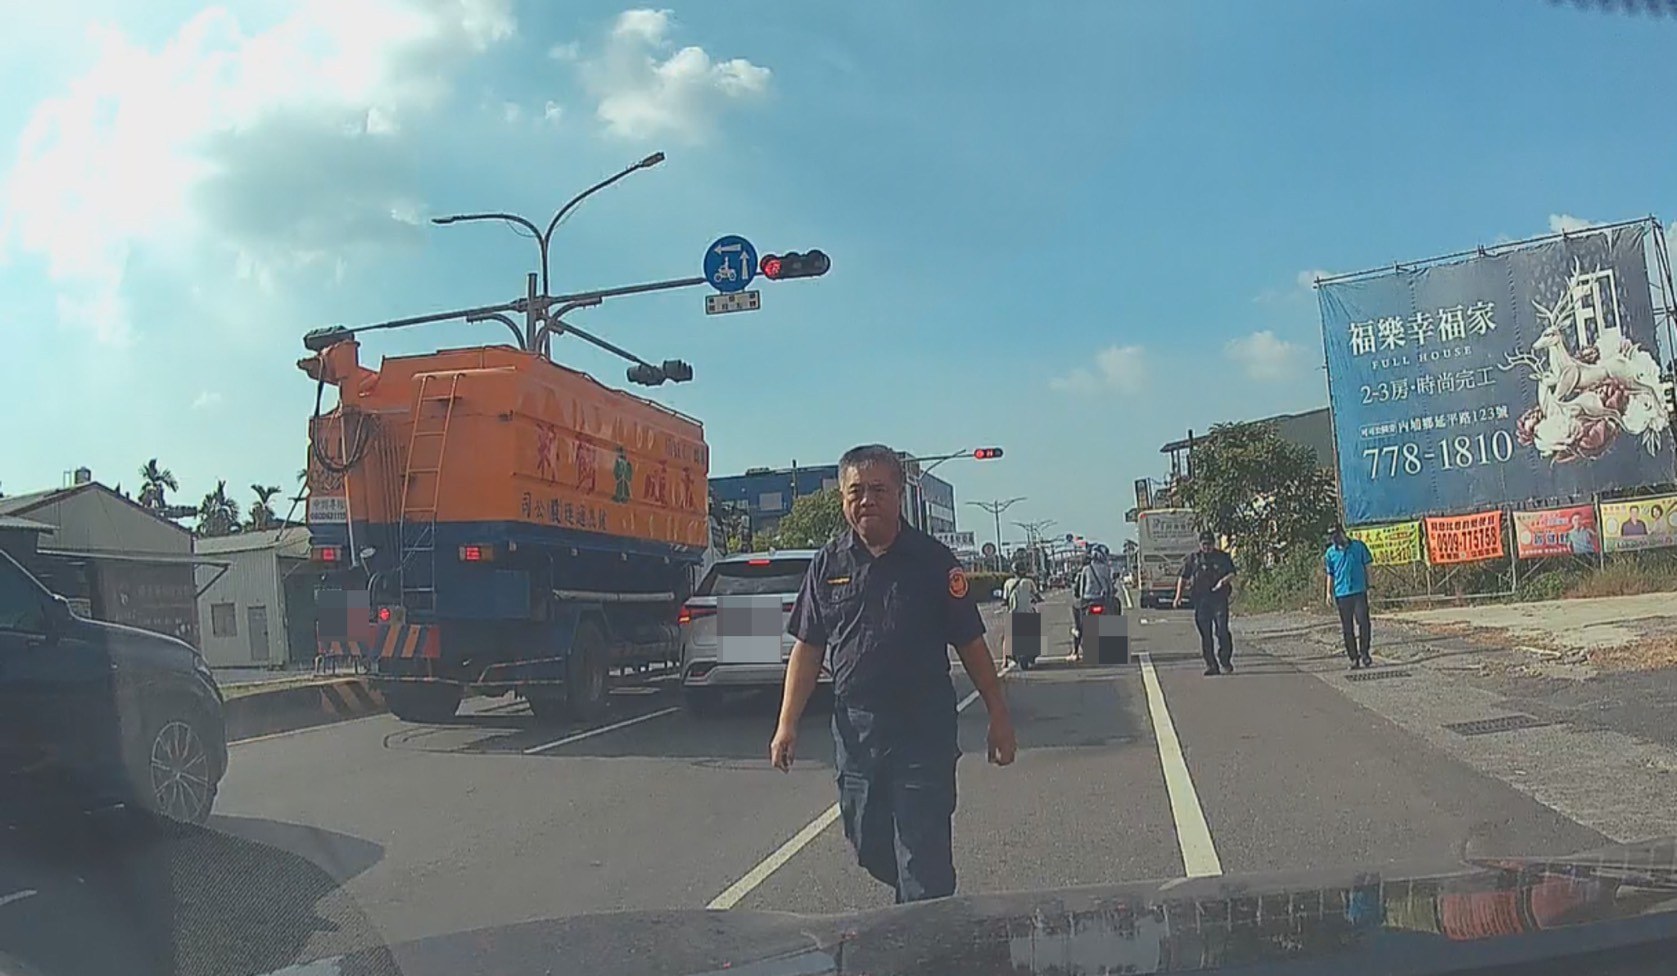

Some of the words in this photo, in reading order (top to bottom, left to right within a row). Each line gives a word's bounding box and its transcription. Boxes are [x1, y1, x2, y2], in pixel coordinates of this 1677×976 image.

[1349, 302, 1497, 355] 福樂幸福家
[1372, 356, 1410, 370] FULL
[1419, 345, 1473, 363] HOUSE
[1363, 430, 1514, 480] 778-1810
